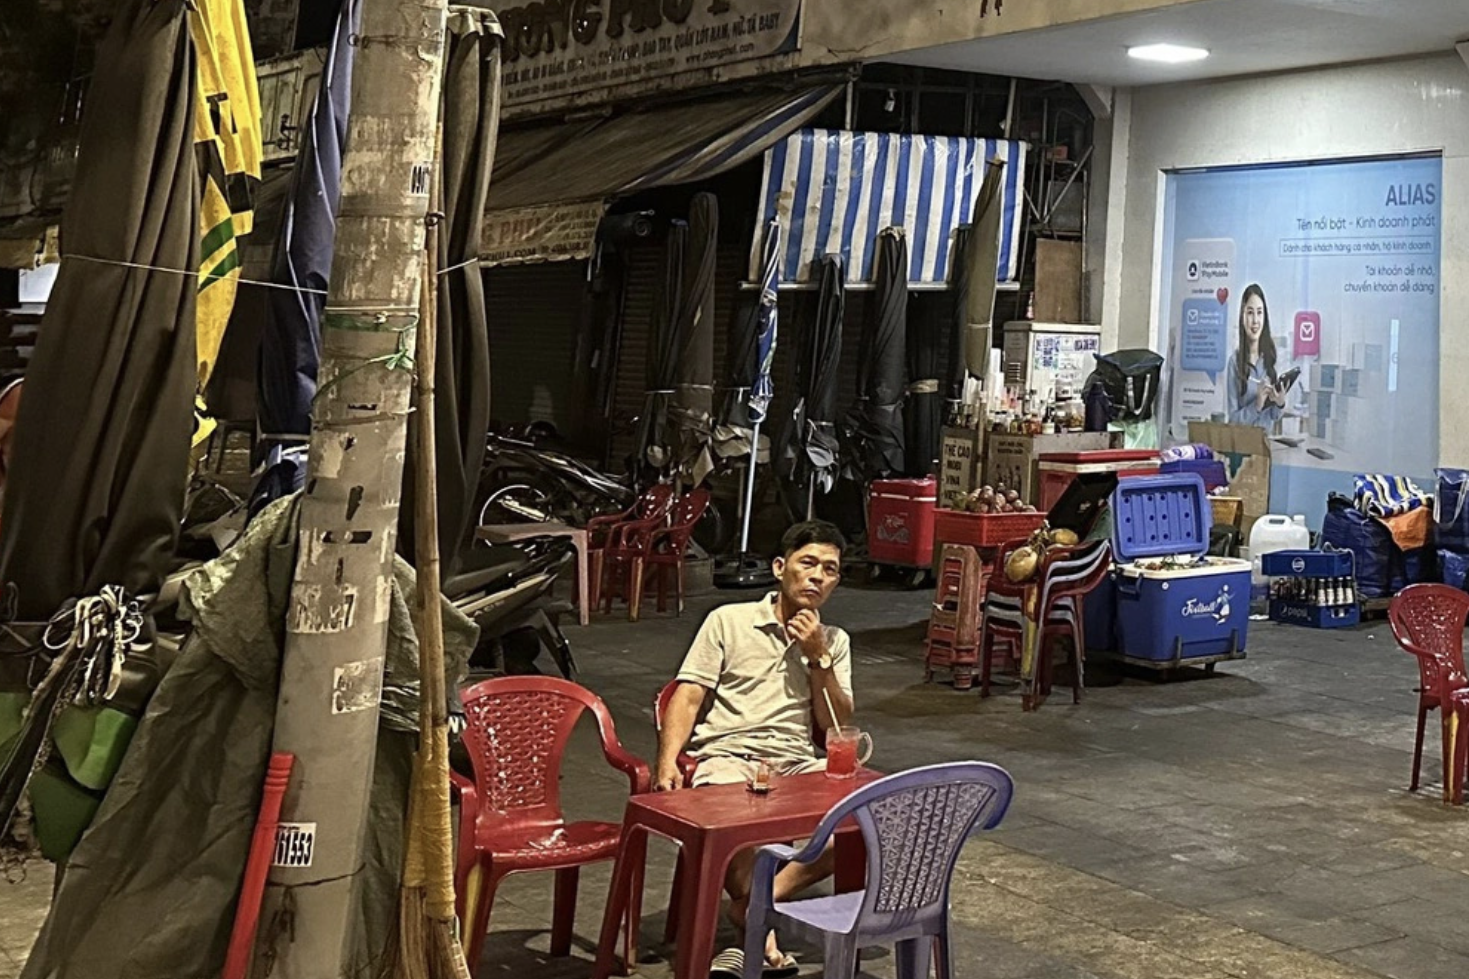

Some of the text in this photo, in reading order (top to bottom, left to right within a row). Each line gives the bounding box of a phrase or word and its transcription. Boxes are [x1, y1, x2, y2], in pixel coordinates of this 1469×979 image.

[1385, 182, 1436, 207] ALIAS
[1296, 217, 1313, 231] Tên
[1355, 215, 1377, 229] Kinh
[1377, 215, 1410, 229] doanh
[272, 832, 313, 865] 61553
